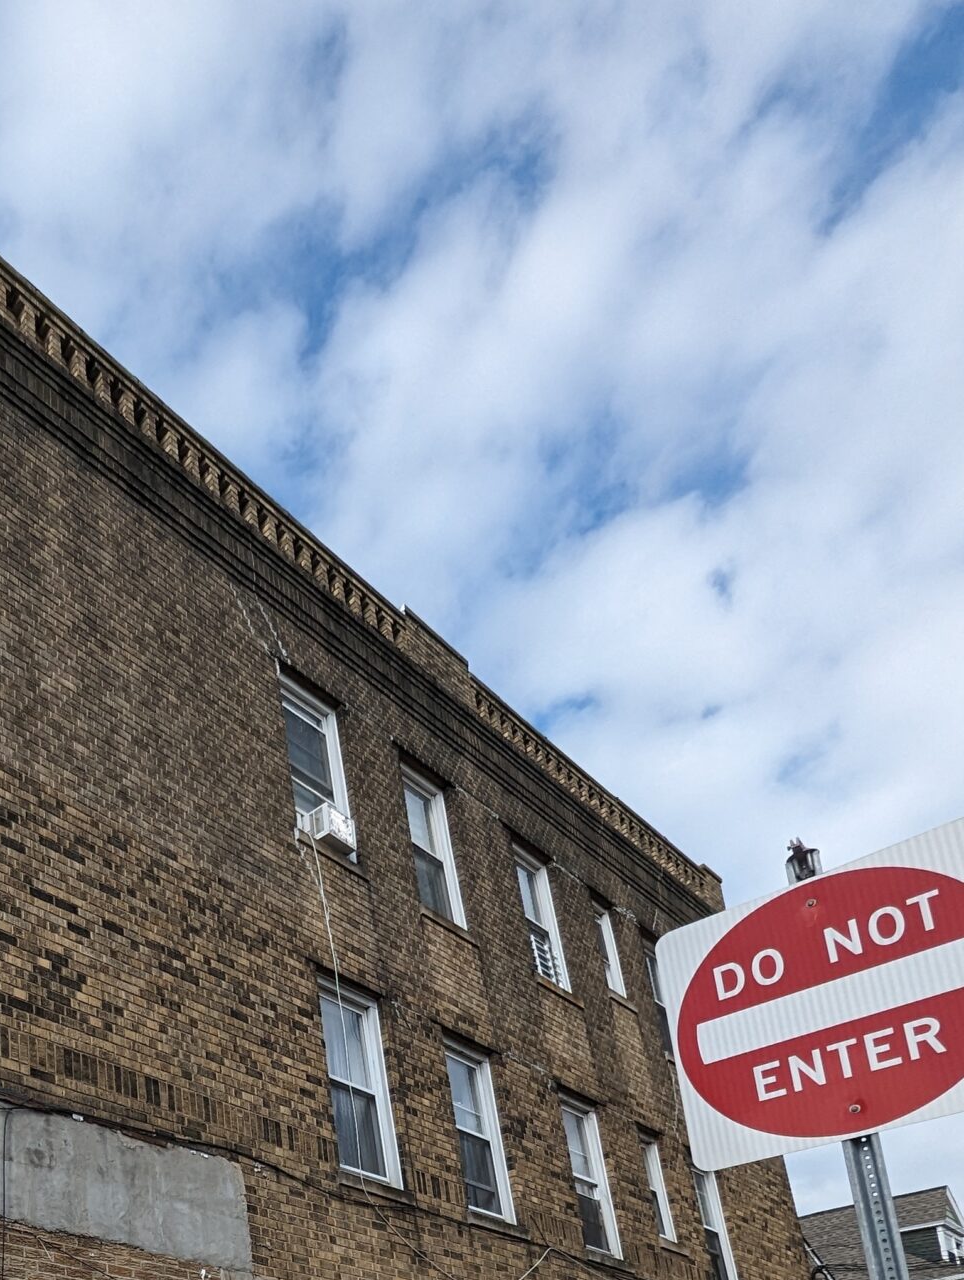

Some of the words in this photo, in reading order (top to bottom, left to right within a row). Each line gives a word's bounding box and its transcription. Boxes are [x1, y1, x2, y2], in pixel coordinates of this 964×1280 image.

[713, 948, 785, 1001] DO
[823, 888, 940, 964] NOT
[753, 1017, 948, 1102] ENTER
